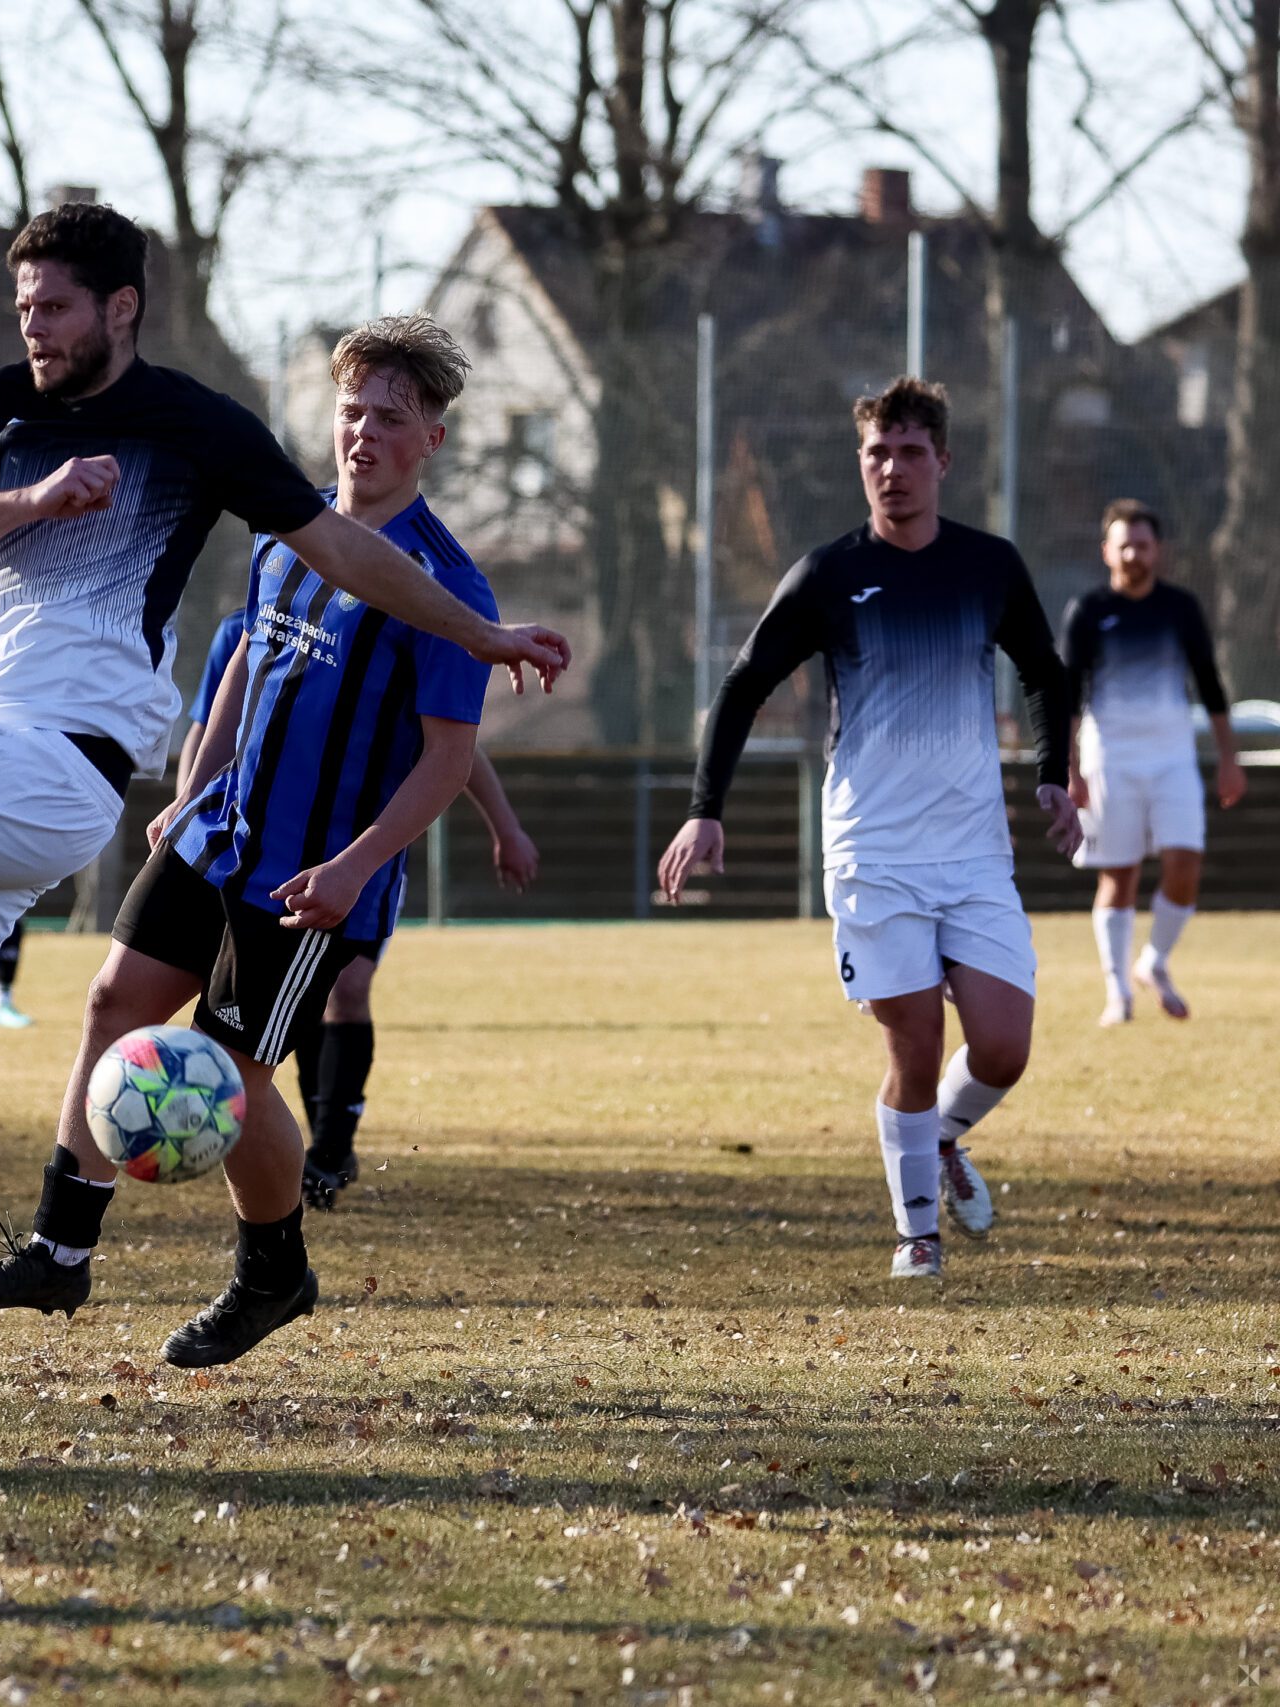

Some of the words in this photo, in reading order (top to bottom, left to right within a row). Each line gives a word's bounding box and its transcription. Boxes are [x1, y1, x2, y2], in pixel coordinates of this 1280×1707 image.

[259, 603, 337, 646] Jihozápadní
[312, 647, 337, 667] a.s.
[841, 951, 855, 983] 6
[214, 1009, 245, 1031] adidas
